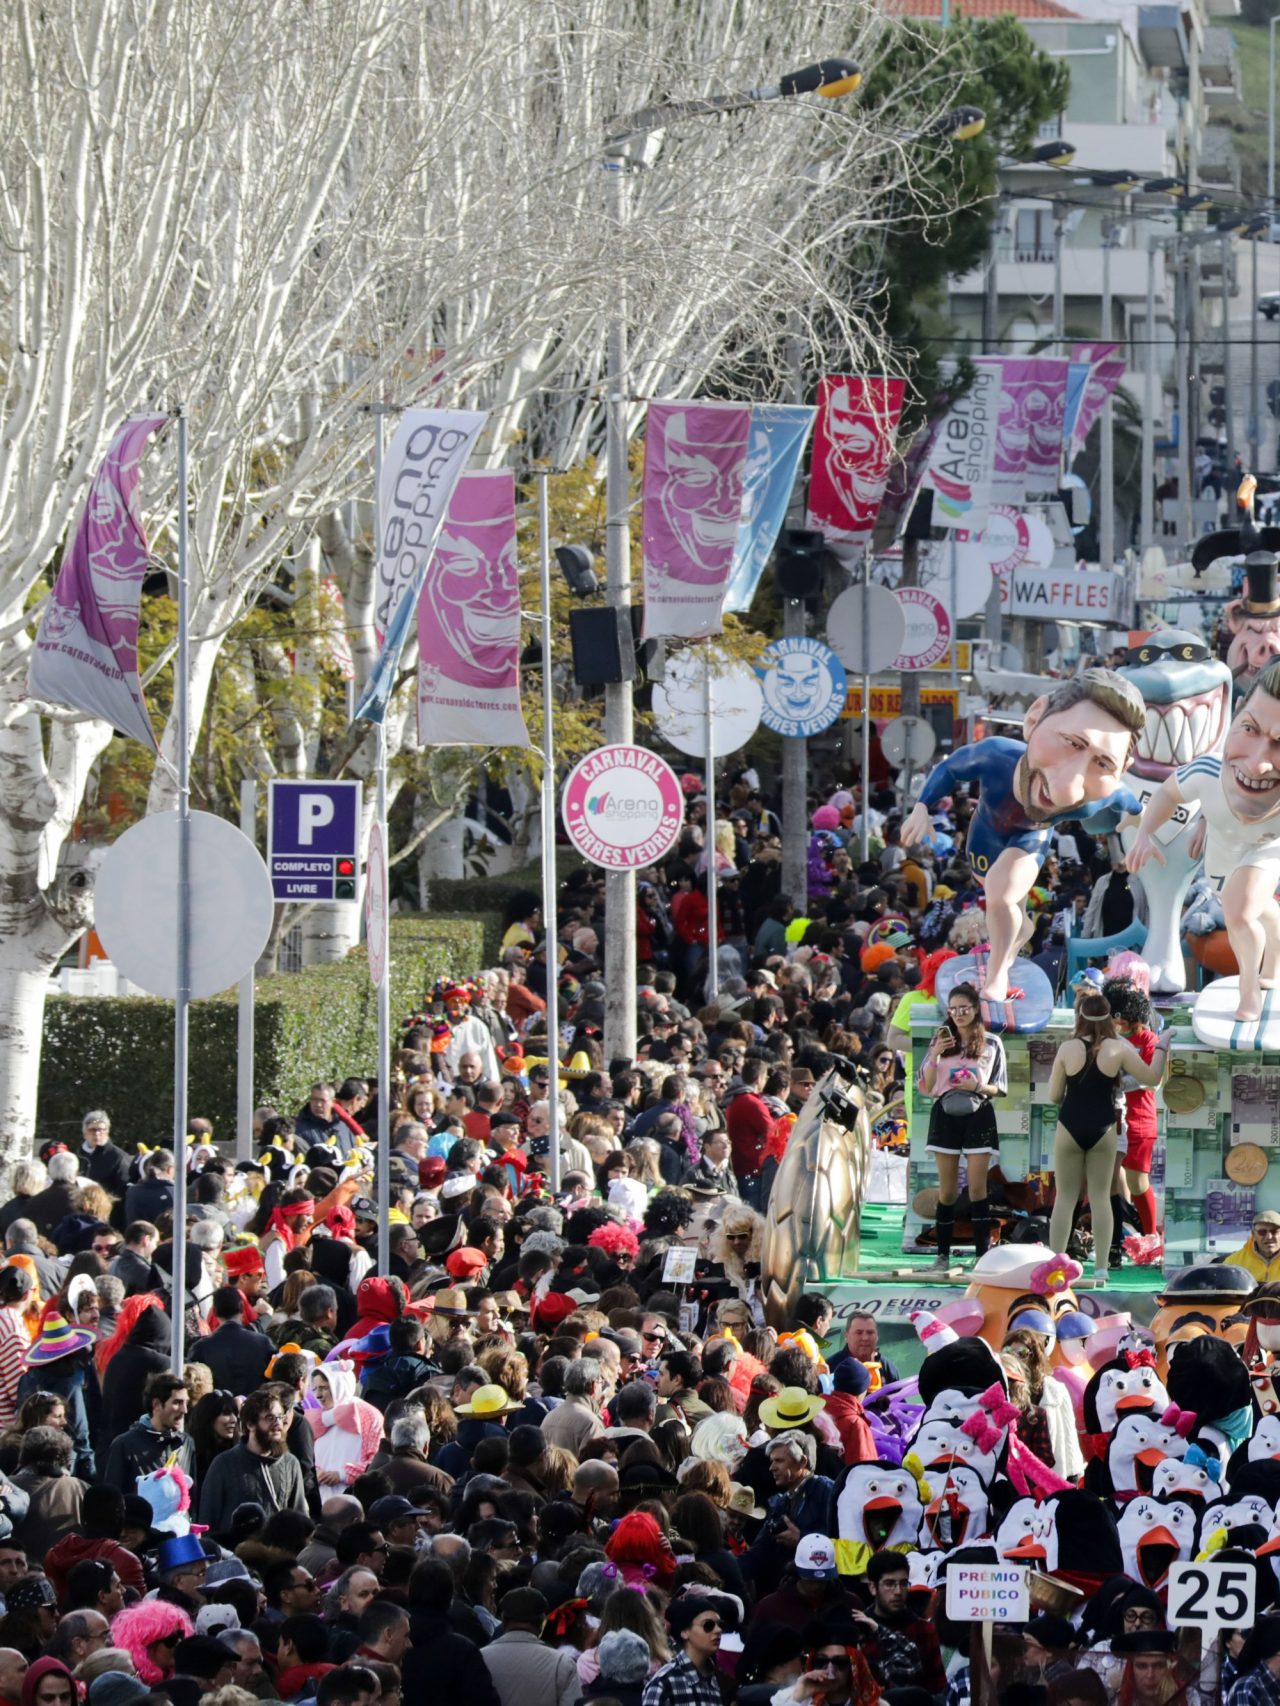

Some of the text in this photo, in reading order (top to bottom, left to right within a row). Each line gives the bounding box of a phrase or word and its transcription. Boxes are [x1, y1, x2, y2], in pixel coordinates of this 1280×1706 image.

[938, 394, 971, 480] Aren
[966, 373, 994, 483] shopping
[1015, 581, 1109, 608] WAFFLES
[801, 692, 845, 737] VEDRAS
[580, 750, 665, 782] CARNAVAL
[606, 797, 659, 811] Arena
[298, 794, 335, 845] P
[570, 814, 678, 866] TORRES VEDRAS
[274, 862, 331, 872] COMPLETO
[286, 884, 317, 894] LIVRE
[886, 1298, 942, 1308] EURO
[959, 1570, 1020, 1582] PRÉMIO
[959, 1587, 1019, 1600] PÚBICO
[1175, 1569, 1249, 1621] 25
[970, 1607, 1007, 1618] 2019
